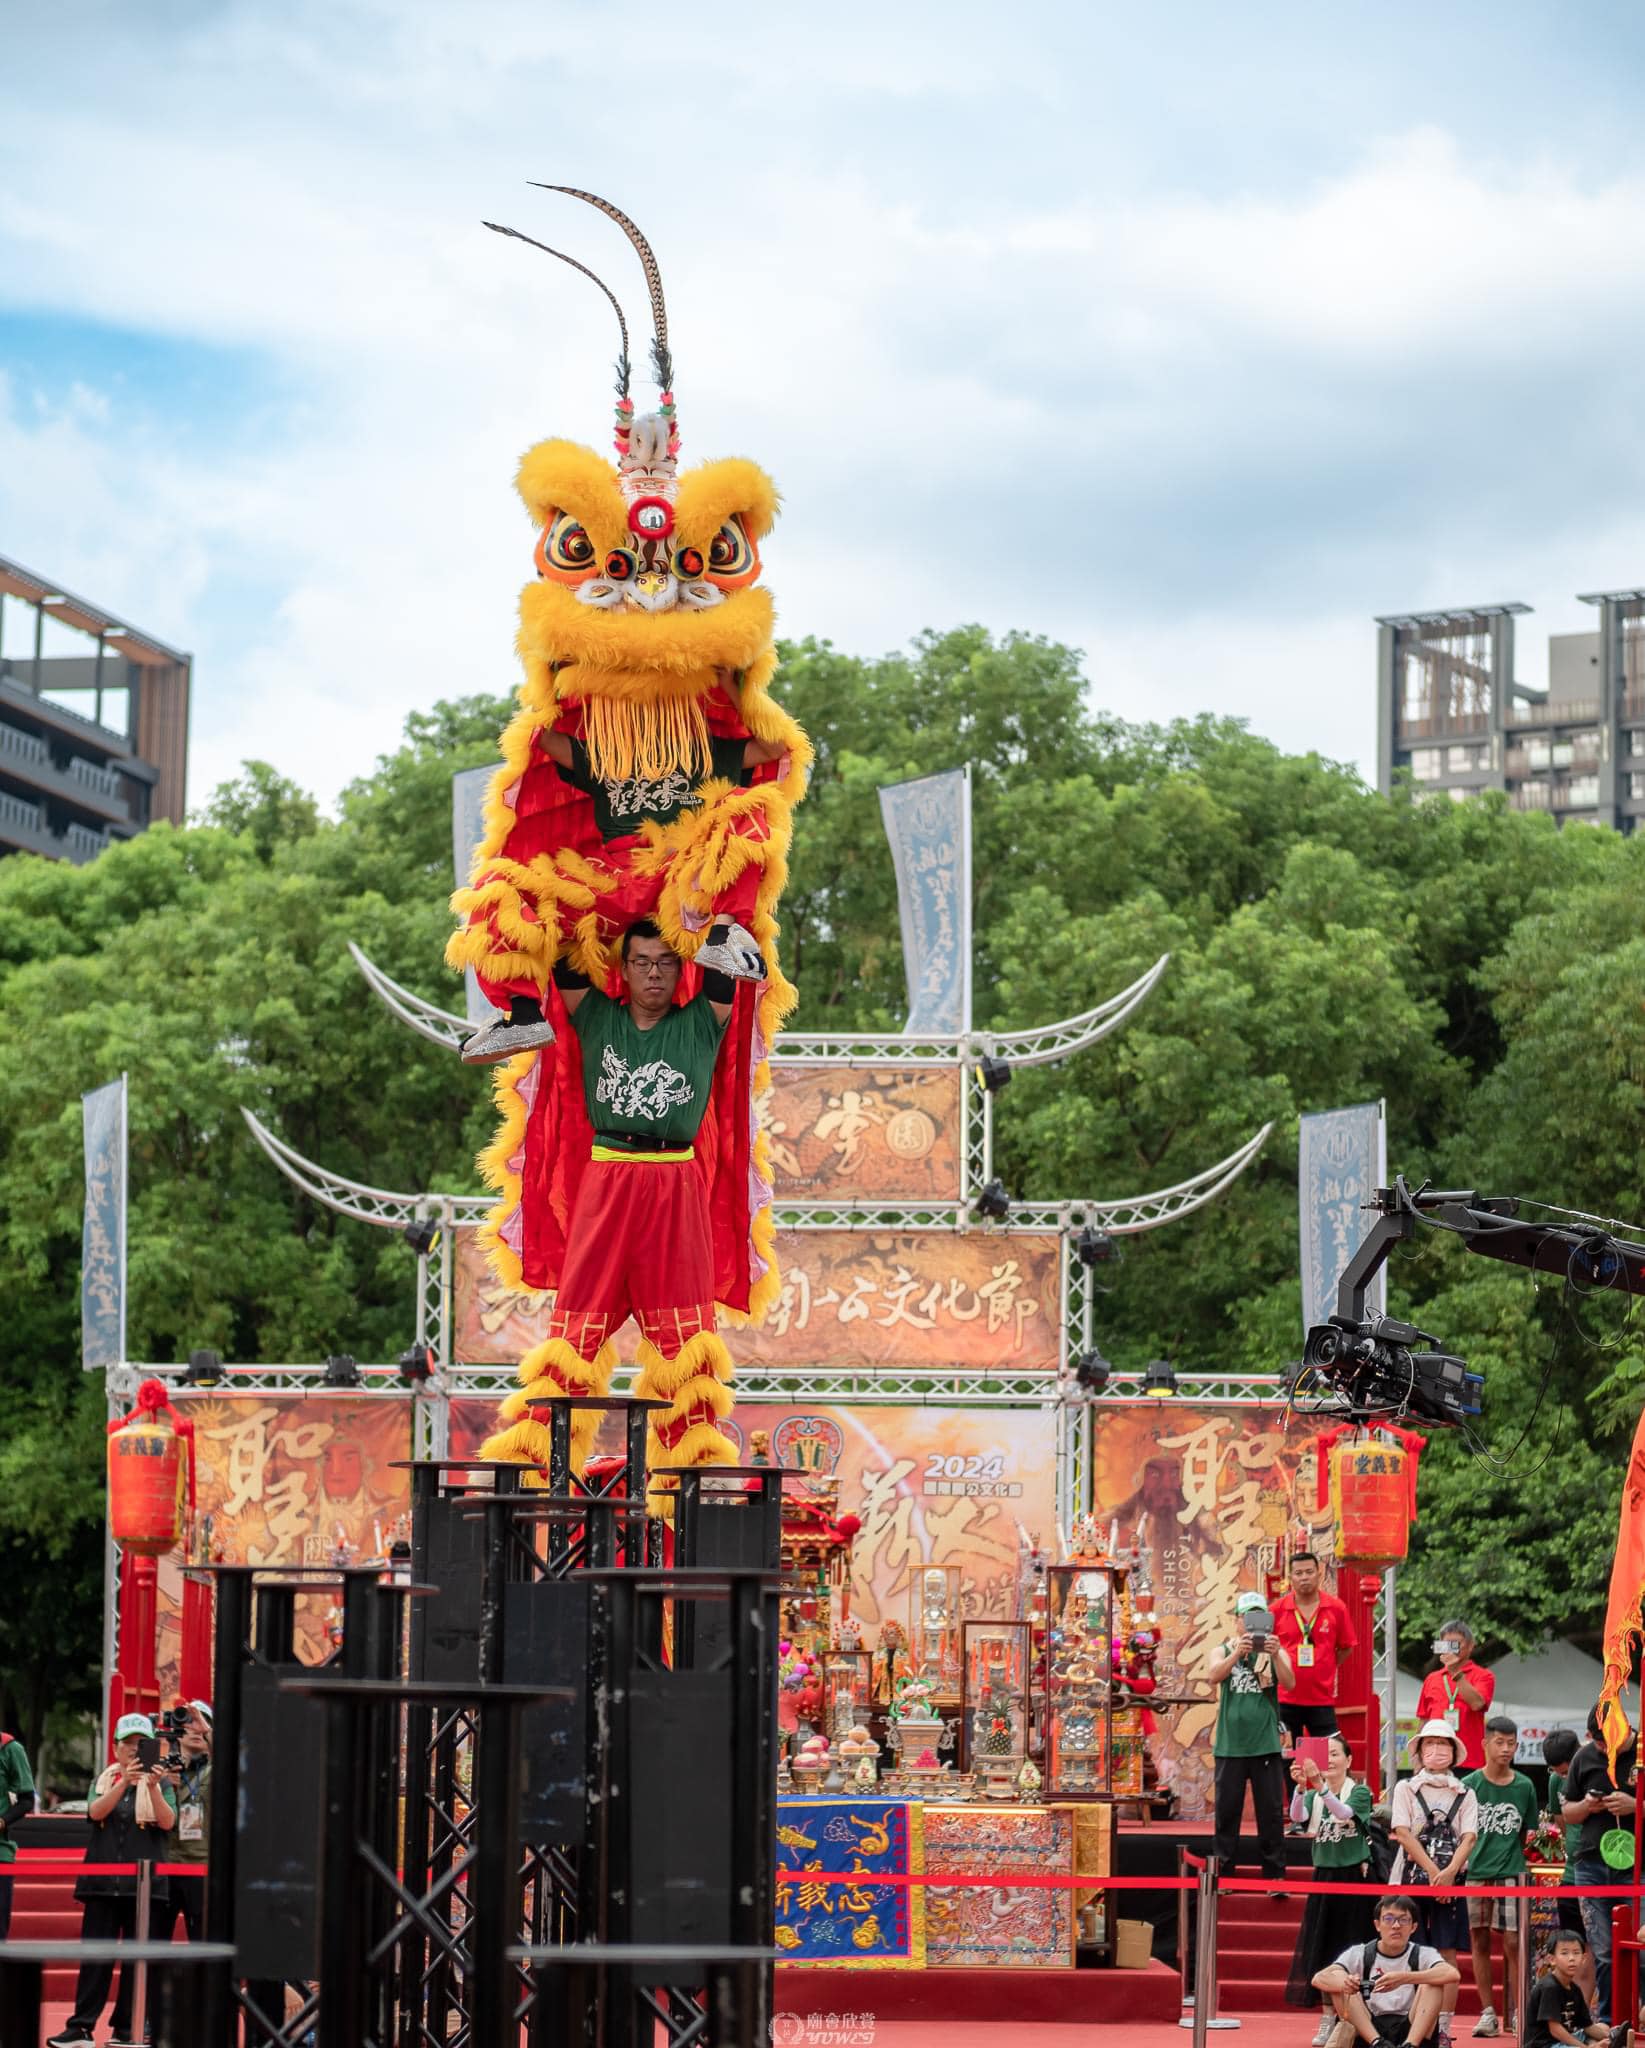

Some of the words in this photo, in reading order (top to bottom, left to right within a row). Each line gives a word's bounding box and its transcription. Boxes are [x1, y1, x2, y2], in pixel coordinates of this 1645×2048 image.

[923, 1454, 1004, 1480] 2024
[1162, 1549, 1177, 1615] SHENG
[1177, 1533, 1192, 1627] TAOYUAN
[1161, 1653, 1176, 1721] TEMPE
